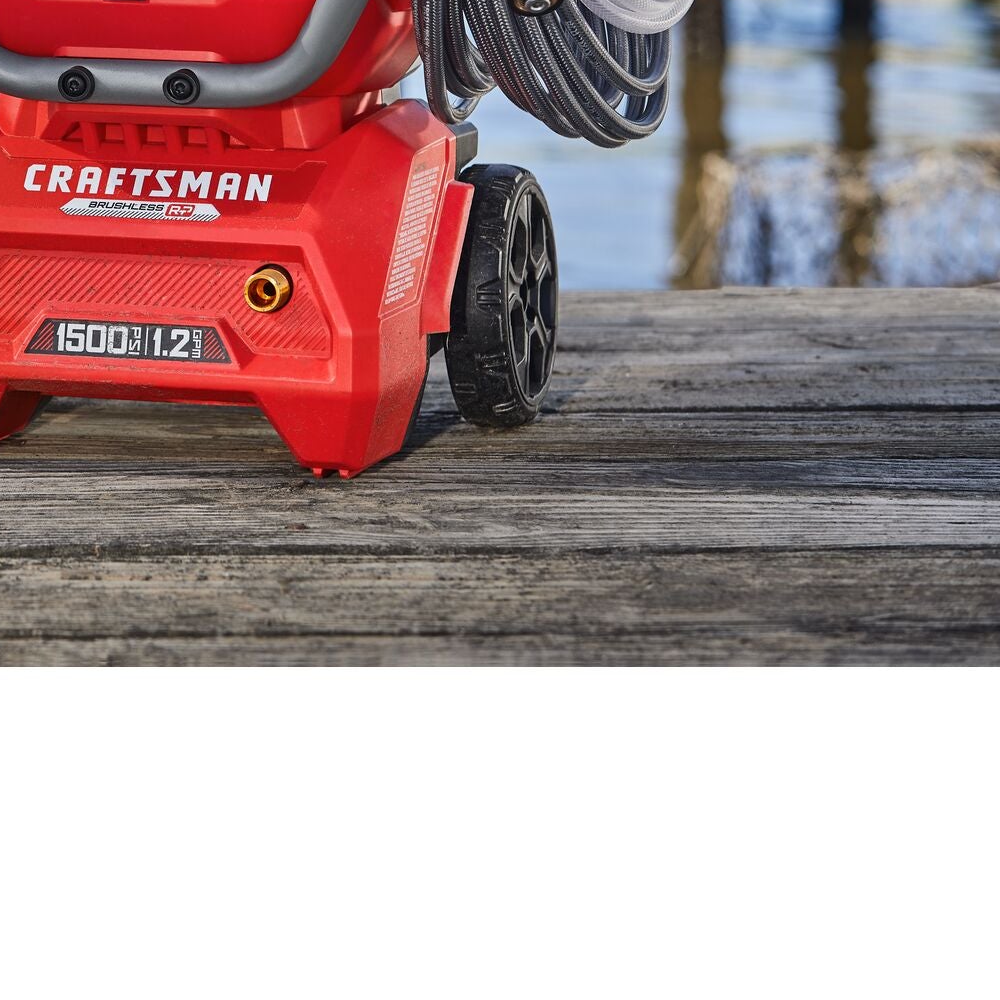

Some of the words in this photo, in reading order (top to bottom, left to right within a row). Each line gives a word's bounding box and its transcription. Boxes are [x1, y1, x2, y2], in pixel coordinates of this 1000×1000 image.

[24, 164, 273, 202] CRAFTSMAN
[88, 201, 165, 212] BRUSHLESS
[56, 322, 129, 354] 1500
[128, 326, 142, 356] PSI
[153, 328, 191, 358] 1.2
